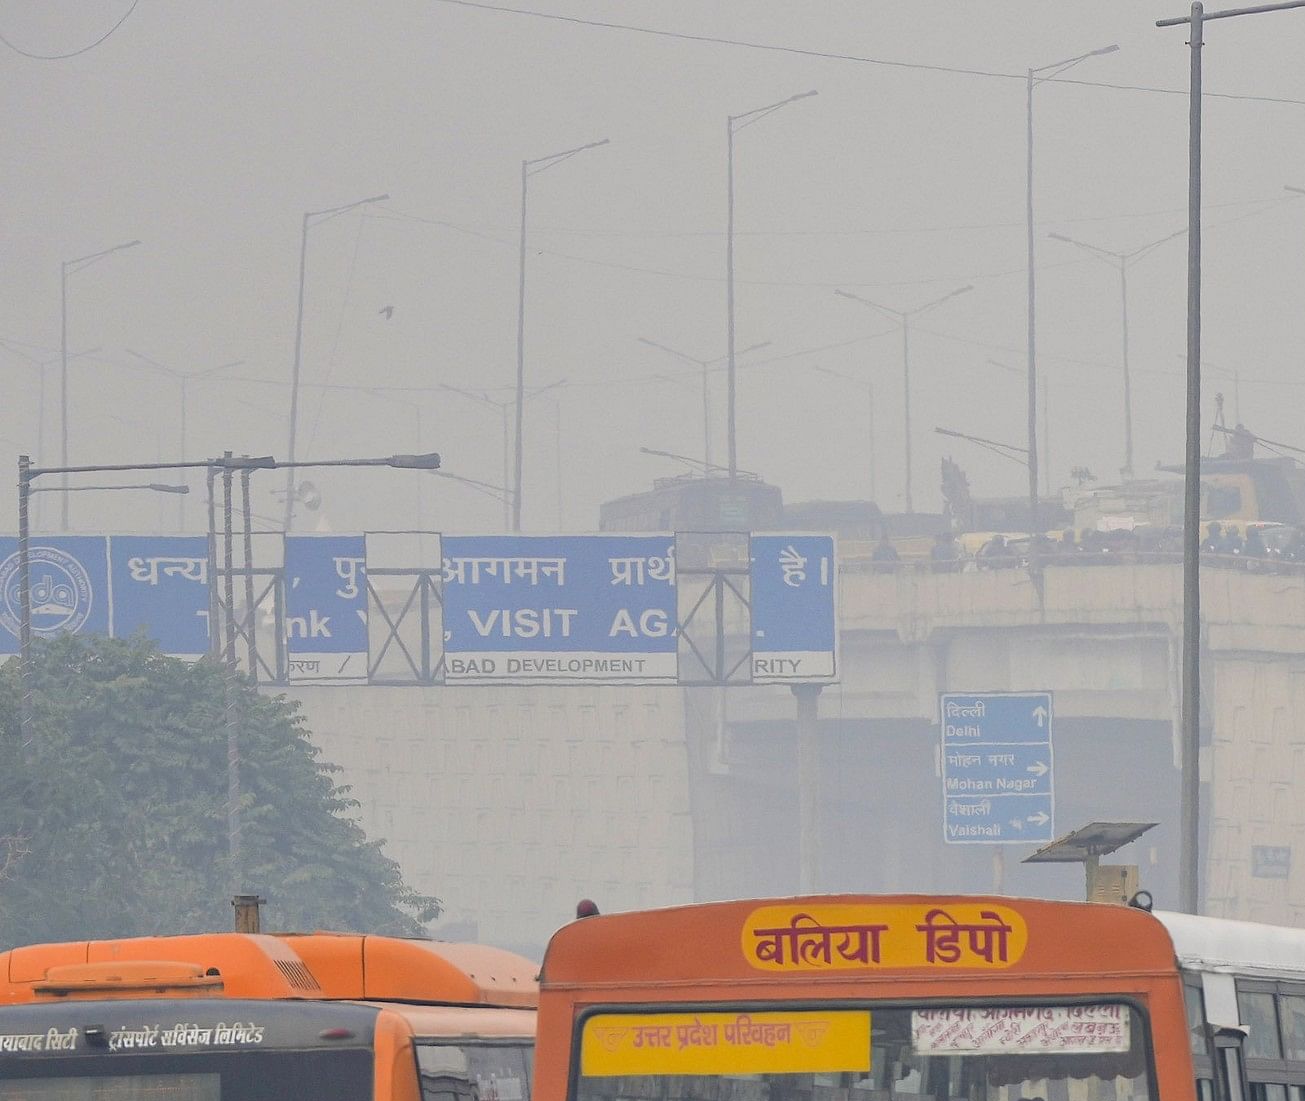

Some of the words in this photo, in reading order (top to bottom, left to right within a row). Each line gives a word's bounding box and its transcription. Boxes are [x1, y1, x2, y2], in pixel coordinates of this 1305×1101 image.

[467, 609, 578, 638] VISIT
[507, 658, 646, 674] DEVELOPMENT
[946, 725, 981, 737] Delhi
[946, 778, 993, 790] Mohan
[996, 778, 1038, 791] Nagar
[949, 825, 1001, 837] Vaishali
[754, 912, 888, 967] बलिया
[916, 908, 1012, 964] डिपो
[0, 1033, 45, 1051] याबाद
[45, 1027, 78, 1051] सिटी
[161, 1022, 213, 1047] सर्विसेज
[214, 1021, 265, 1045] लिमिटेड
[632, 1025, 672, 1048] उत्तर
[676, 1018, 718, 1050] प्रदेश
[723, 1013, 792, 1047] परिवहन
